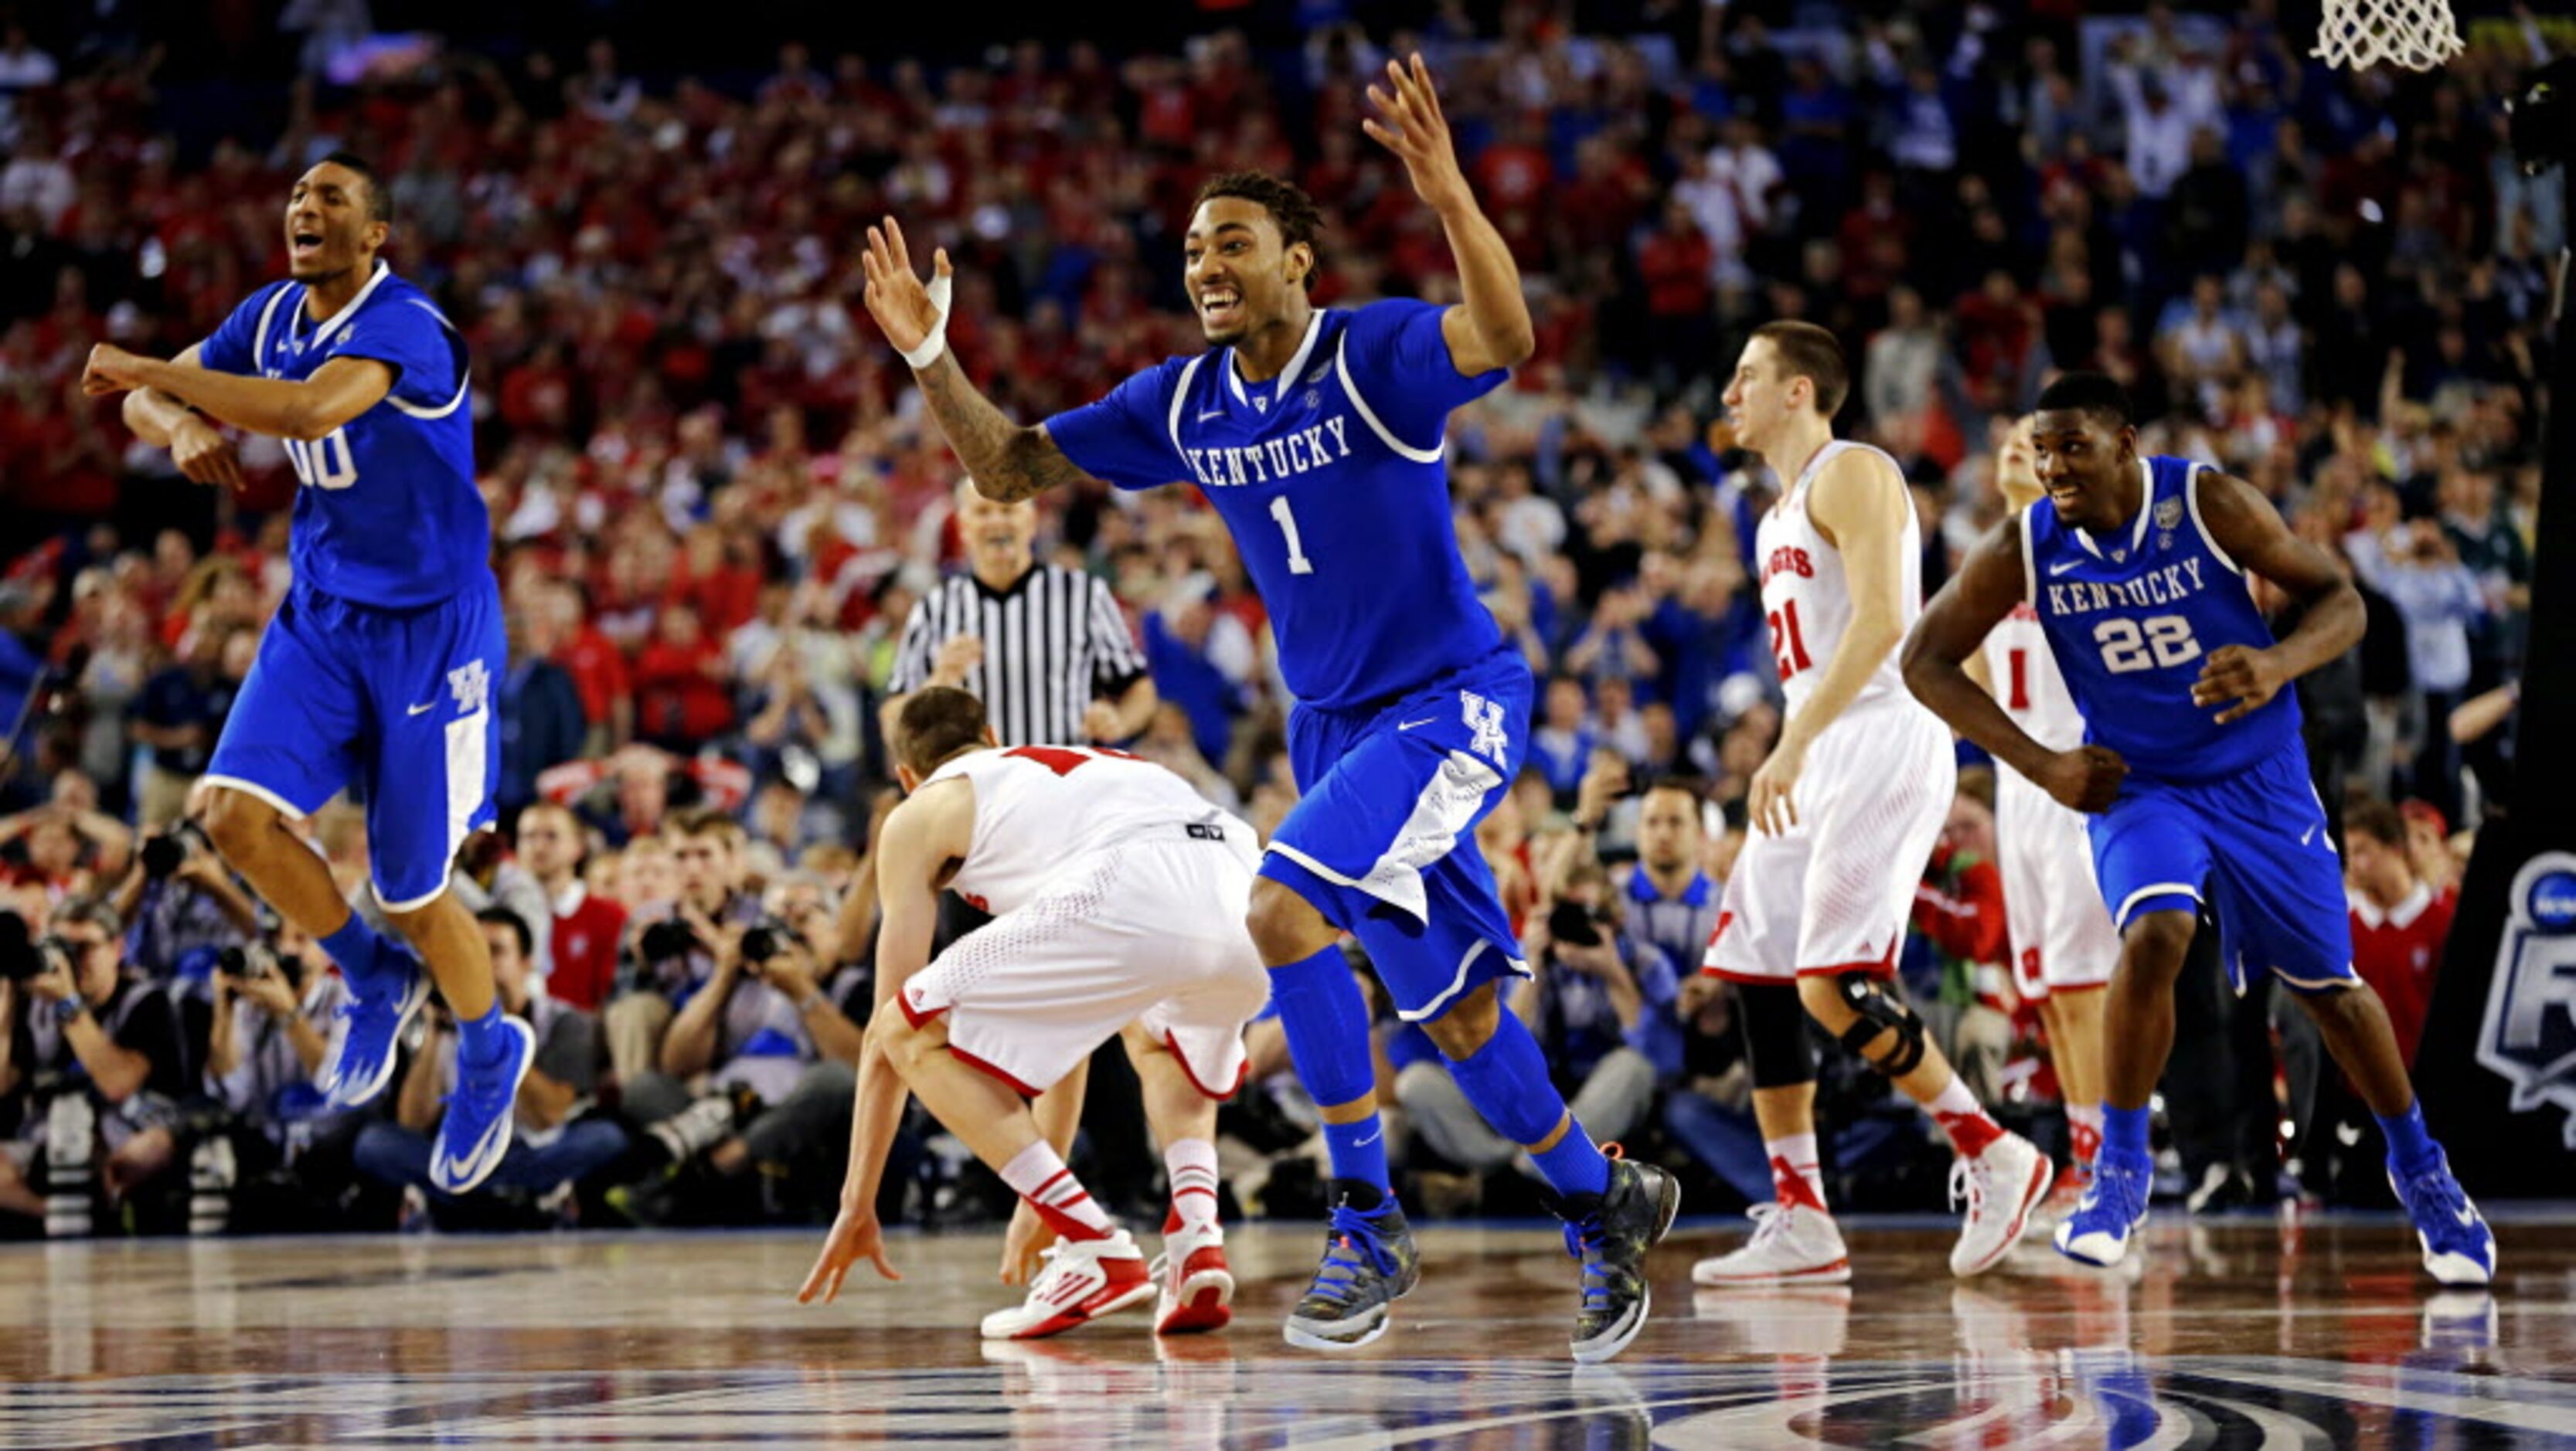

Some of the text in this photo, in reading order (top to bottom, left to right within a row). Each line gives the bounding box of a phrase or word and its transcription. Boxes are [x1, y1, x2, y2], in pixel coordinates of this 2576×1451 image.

[1186, 414, 1351, 487] KENTUCKY
[1269, 494, 1314, 575] 1
[2047, 556, 2205, 616] KENTUCKY
[1767, 597, 1812, 682] 21
[2092, 614, 2203, 675] 22
[2009, 648, 2030, 711] 1
